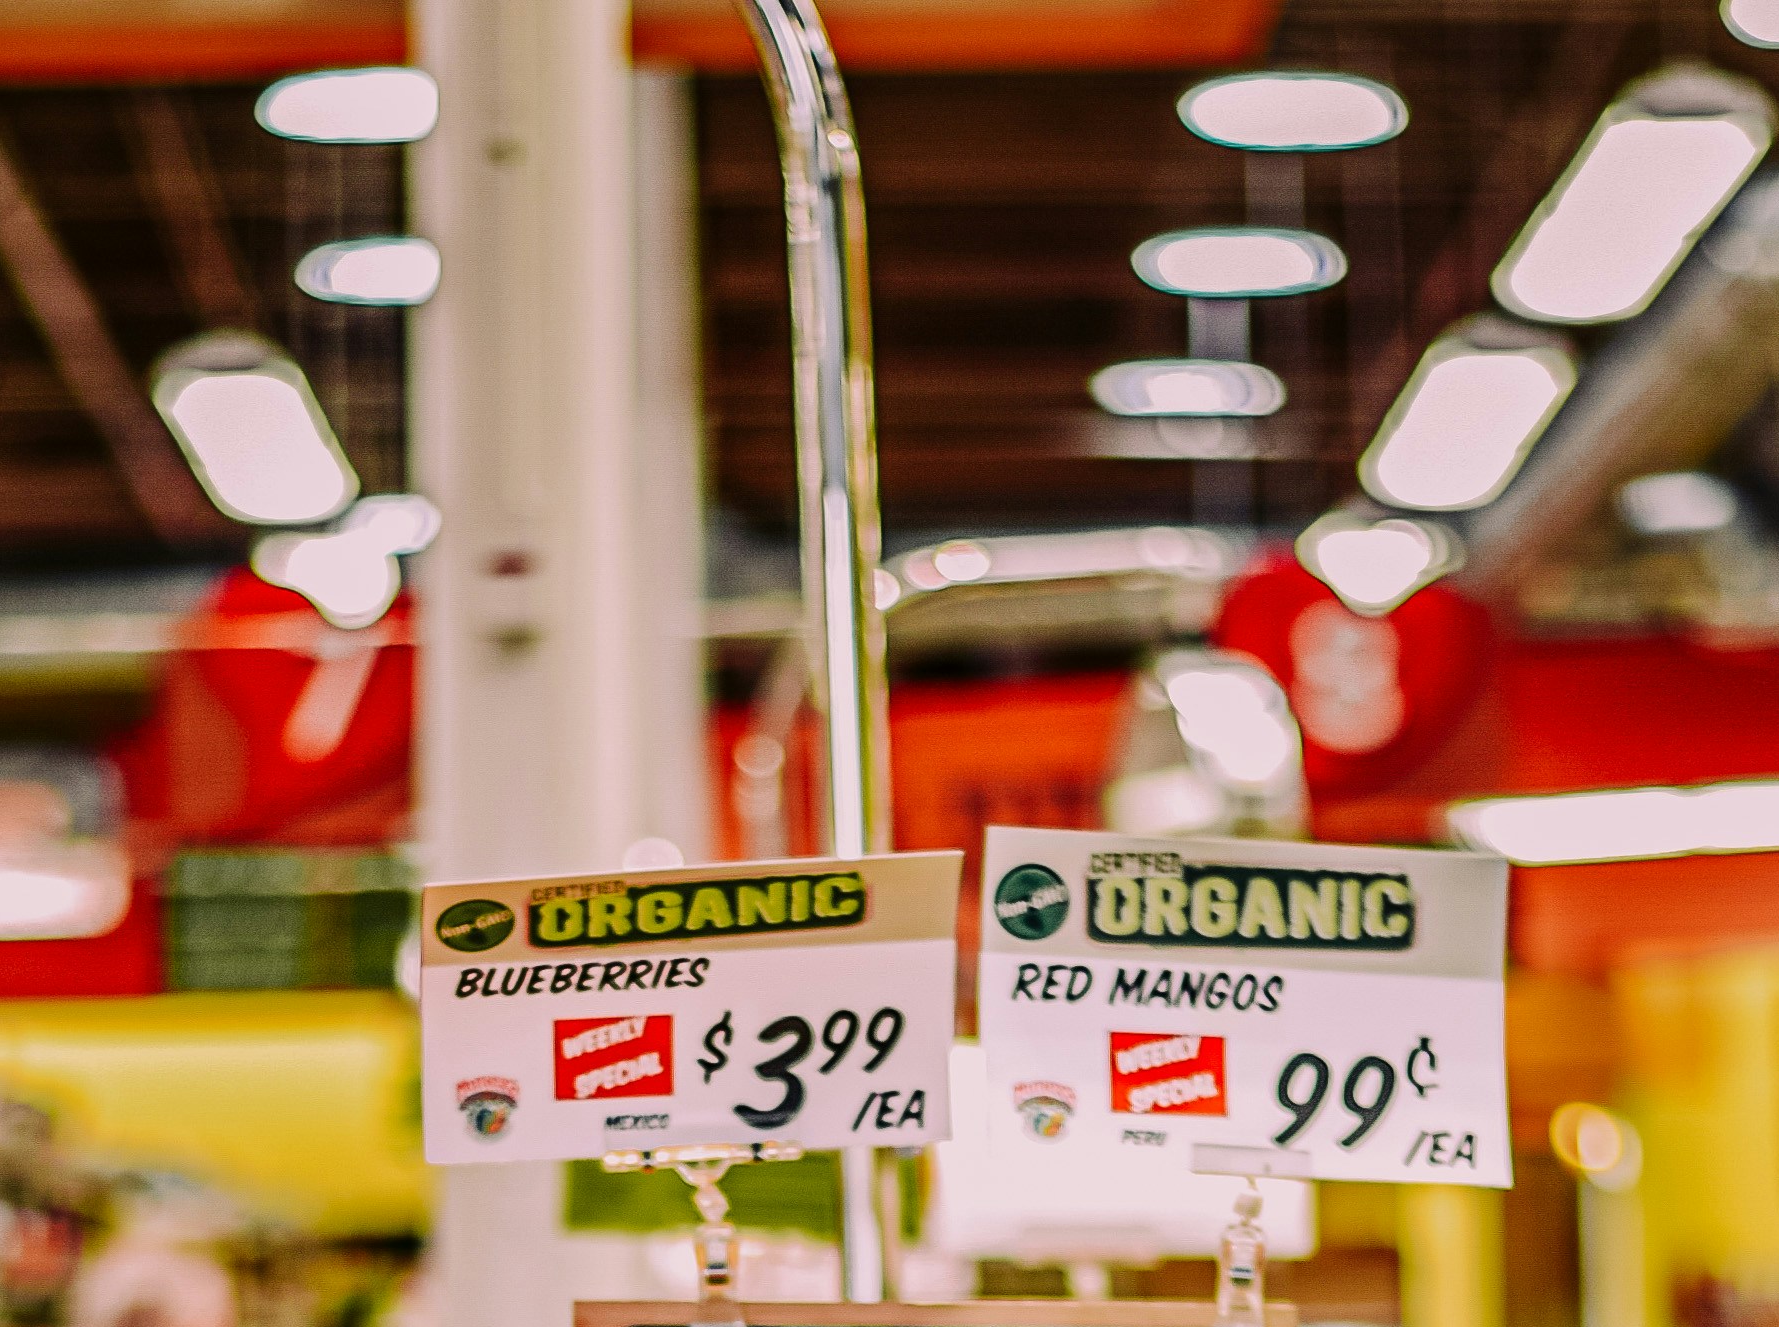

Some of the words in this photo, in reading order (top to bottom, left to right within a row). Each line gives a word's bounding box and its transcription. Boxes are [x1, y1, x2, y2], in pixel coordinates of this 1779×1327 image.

[537, 875, 863, 942] ORGANIC
[1093, 876, 1410, 940] ORGANIC
[454, 957, 711, 999] BLUEBERRIES
[1011, 963, 1092, 1001] RED
[1108, 969, 1285, 1013] MANGOS
[562, 1017, 648, 1059] WEEKLY
[1115, 1035, 1202, 1075] WEEKLY
[575, 1051, 664, 1100] SPECIAL
[1128, 1073, 1219, 1114] SPECIAL
[852, 1089, 925, 1132] /EA
[1403, 1130, 1478, 1169] /EA
